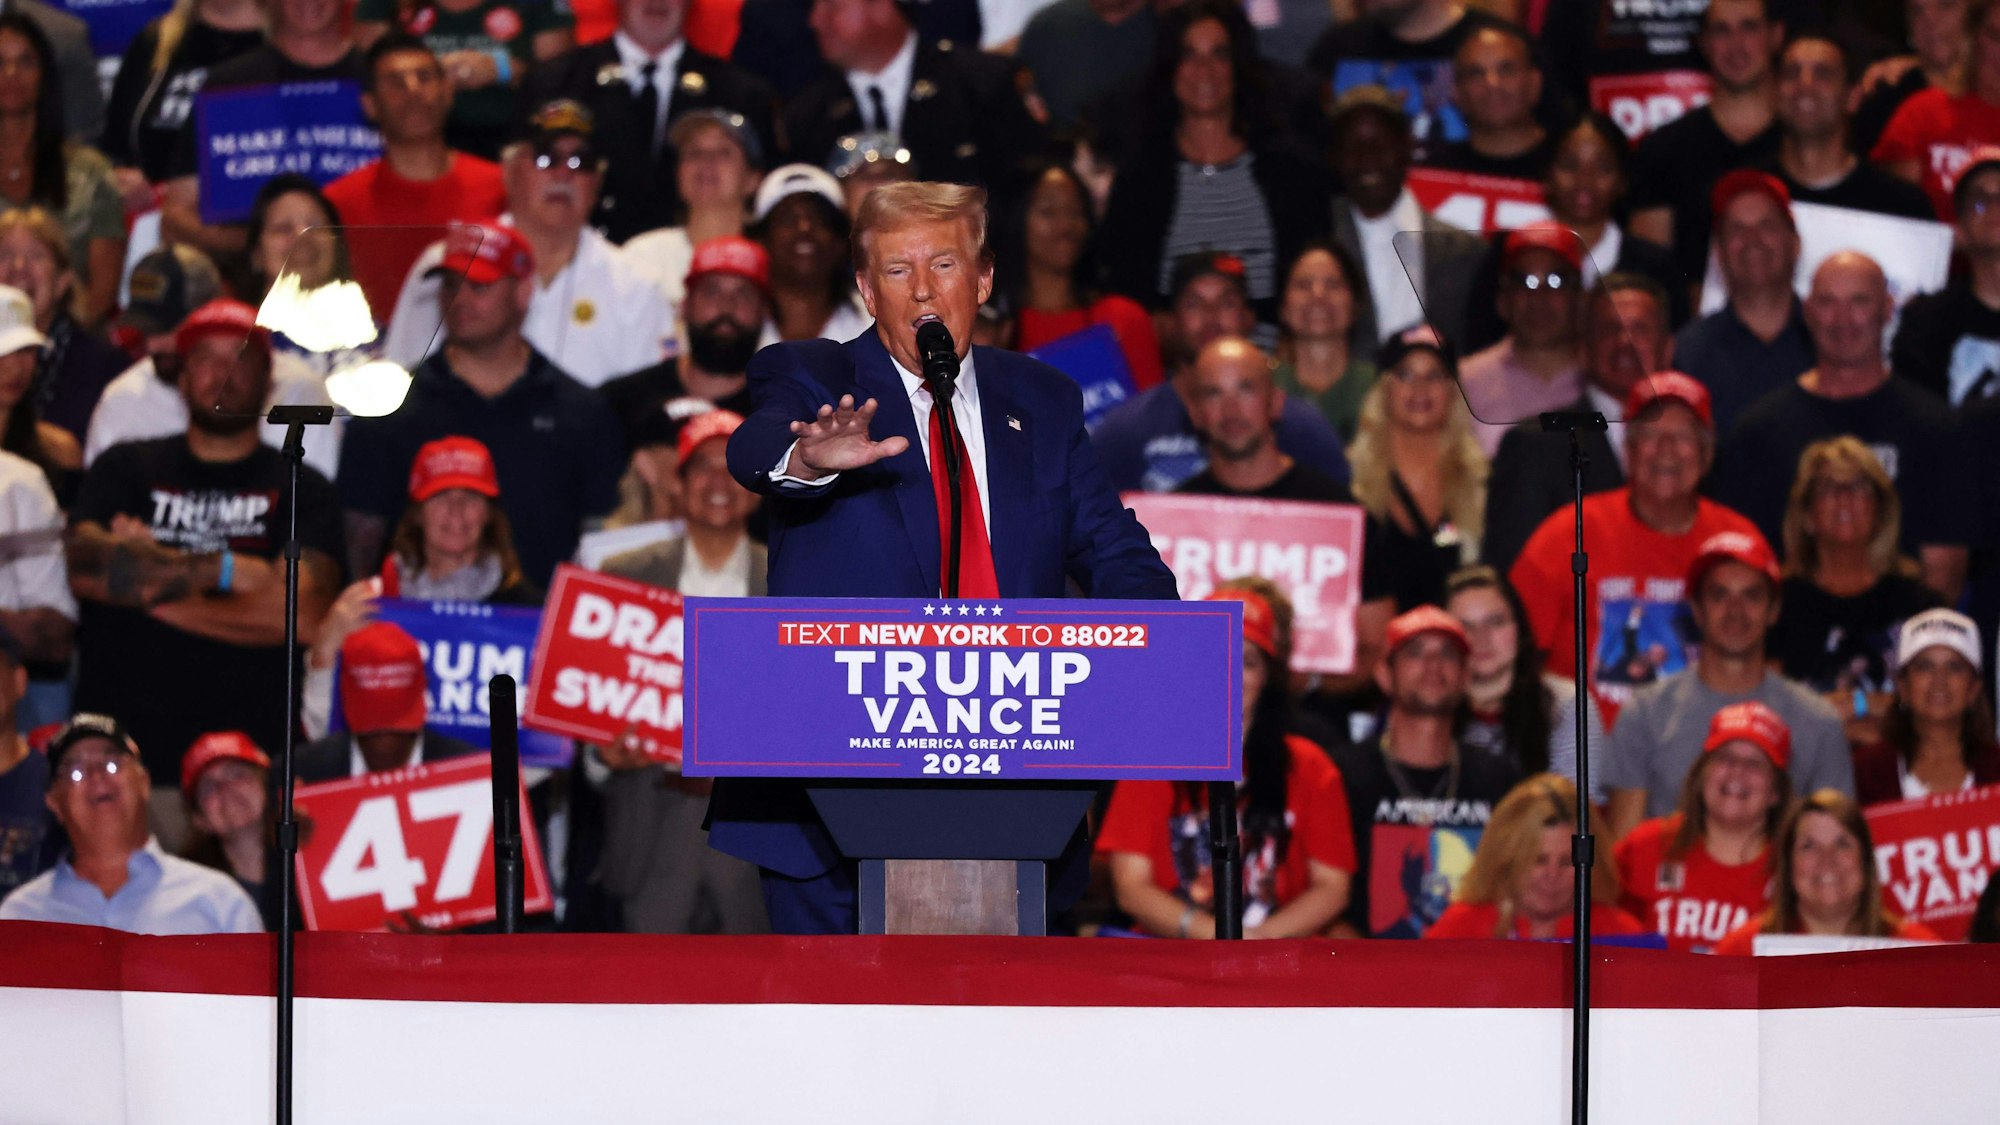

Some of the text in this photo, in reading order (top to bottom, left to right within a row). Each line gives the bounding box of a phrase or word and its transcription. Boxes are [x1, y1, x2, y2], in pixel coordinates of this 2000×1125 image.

[152, 490, 270, 534] TRUMP
[781, 623, 1145, 647] TEXT NEW YORK TO 88022
[834, 650, 1091, 697] TRUMP
[863, 697, 1061, 735] VANCE
[849, 738, 1075, 750] MAKE AMERICA GREAT AGAIN!
[922, 753, 1002, 775] 2024
[319, 777, 493, 912] 47
